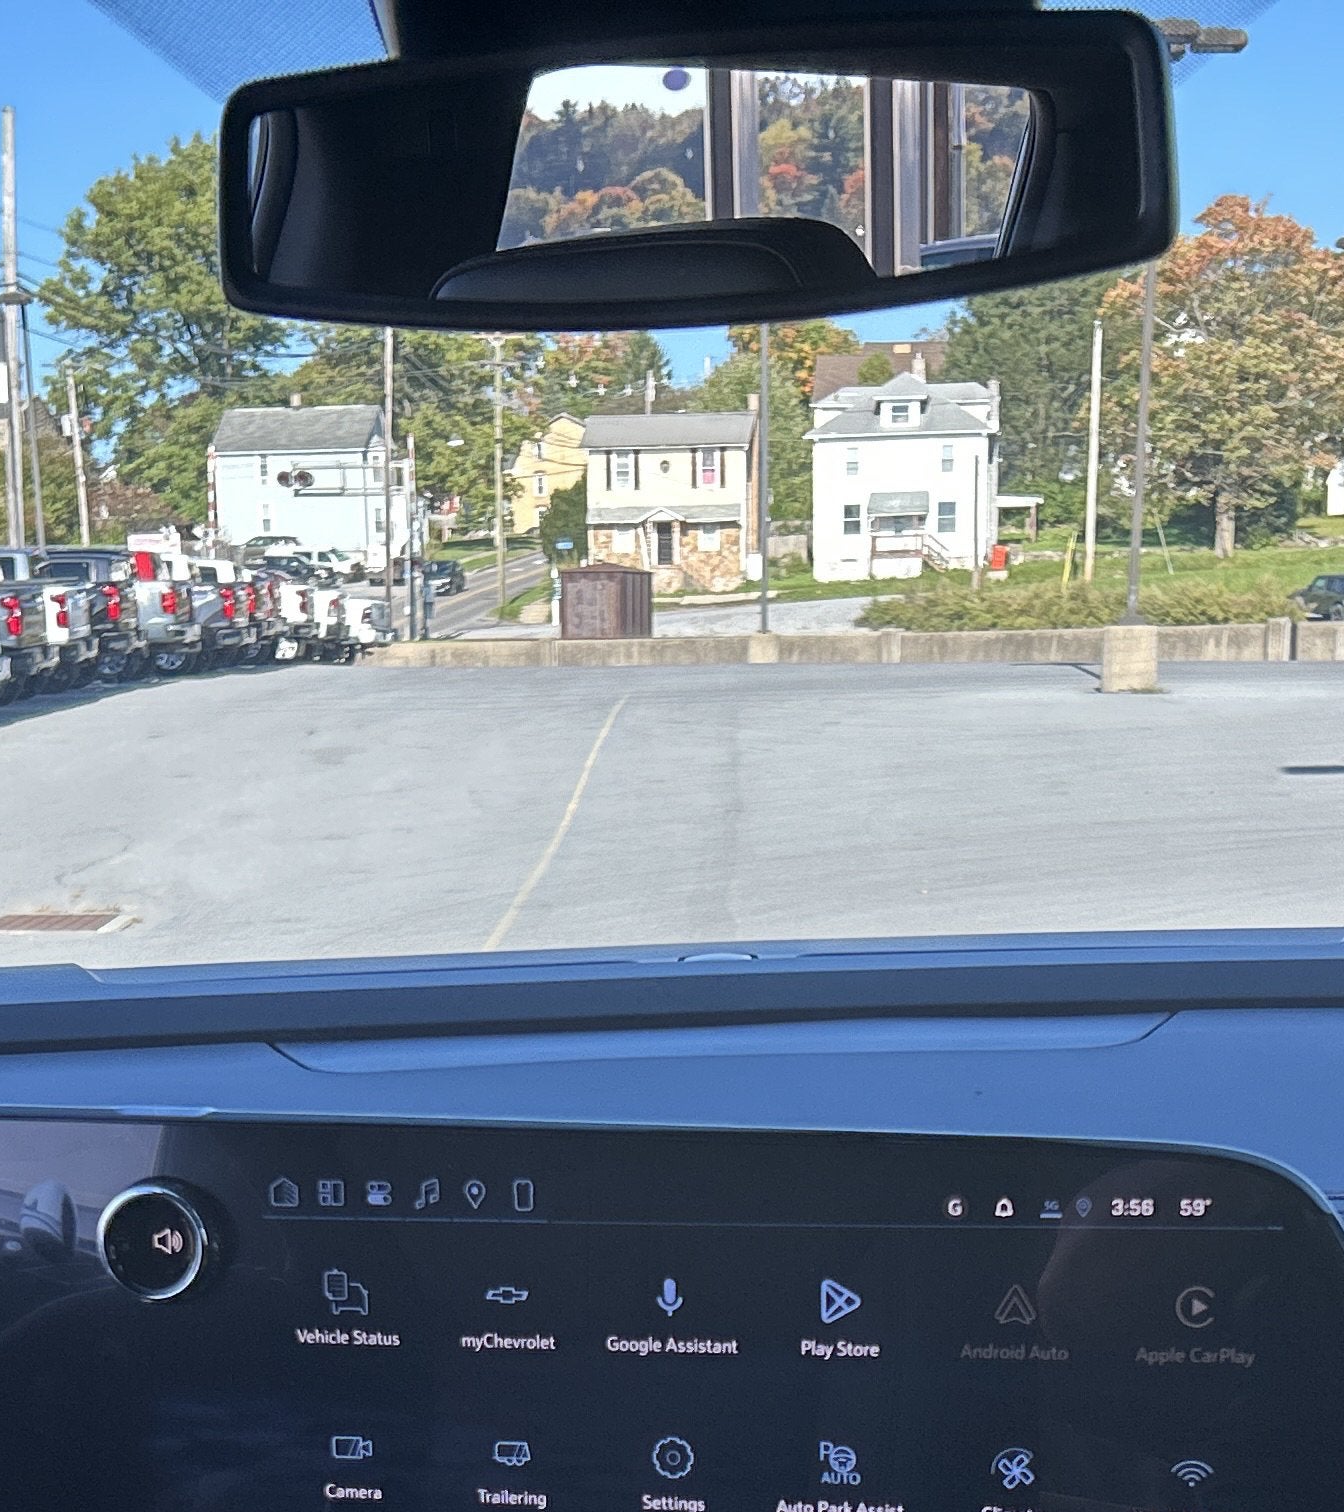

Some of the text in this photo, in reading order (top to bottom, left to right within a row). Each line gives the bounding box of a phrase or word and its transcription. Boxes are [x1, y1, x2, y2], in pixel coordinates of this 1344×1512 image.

[295, 1328, 401, 1347] Vehicle Status
[461, 1333, 556, 1351] myChevrolet
[607, 1336, 739, 1356] Google Assistant
[801, 1339, 880, 1360] Play Store
[960, 1344, 1069, 1361] Android Auto
[1135, 1347, 1256, 1368] Apple CarPlay
[820, 1471, 861, 1486] AUTO
[325, 1484, 383, 1500] Camera
[477, 1488, 547, 1510] Trailering
